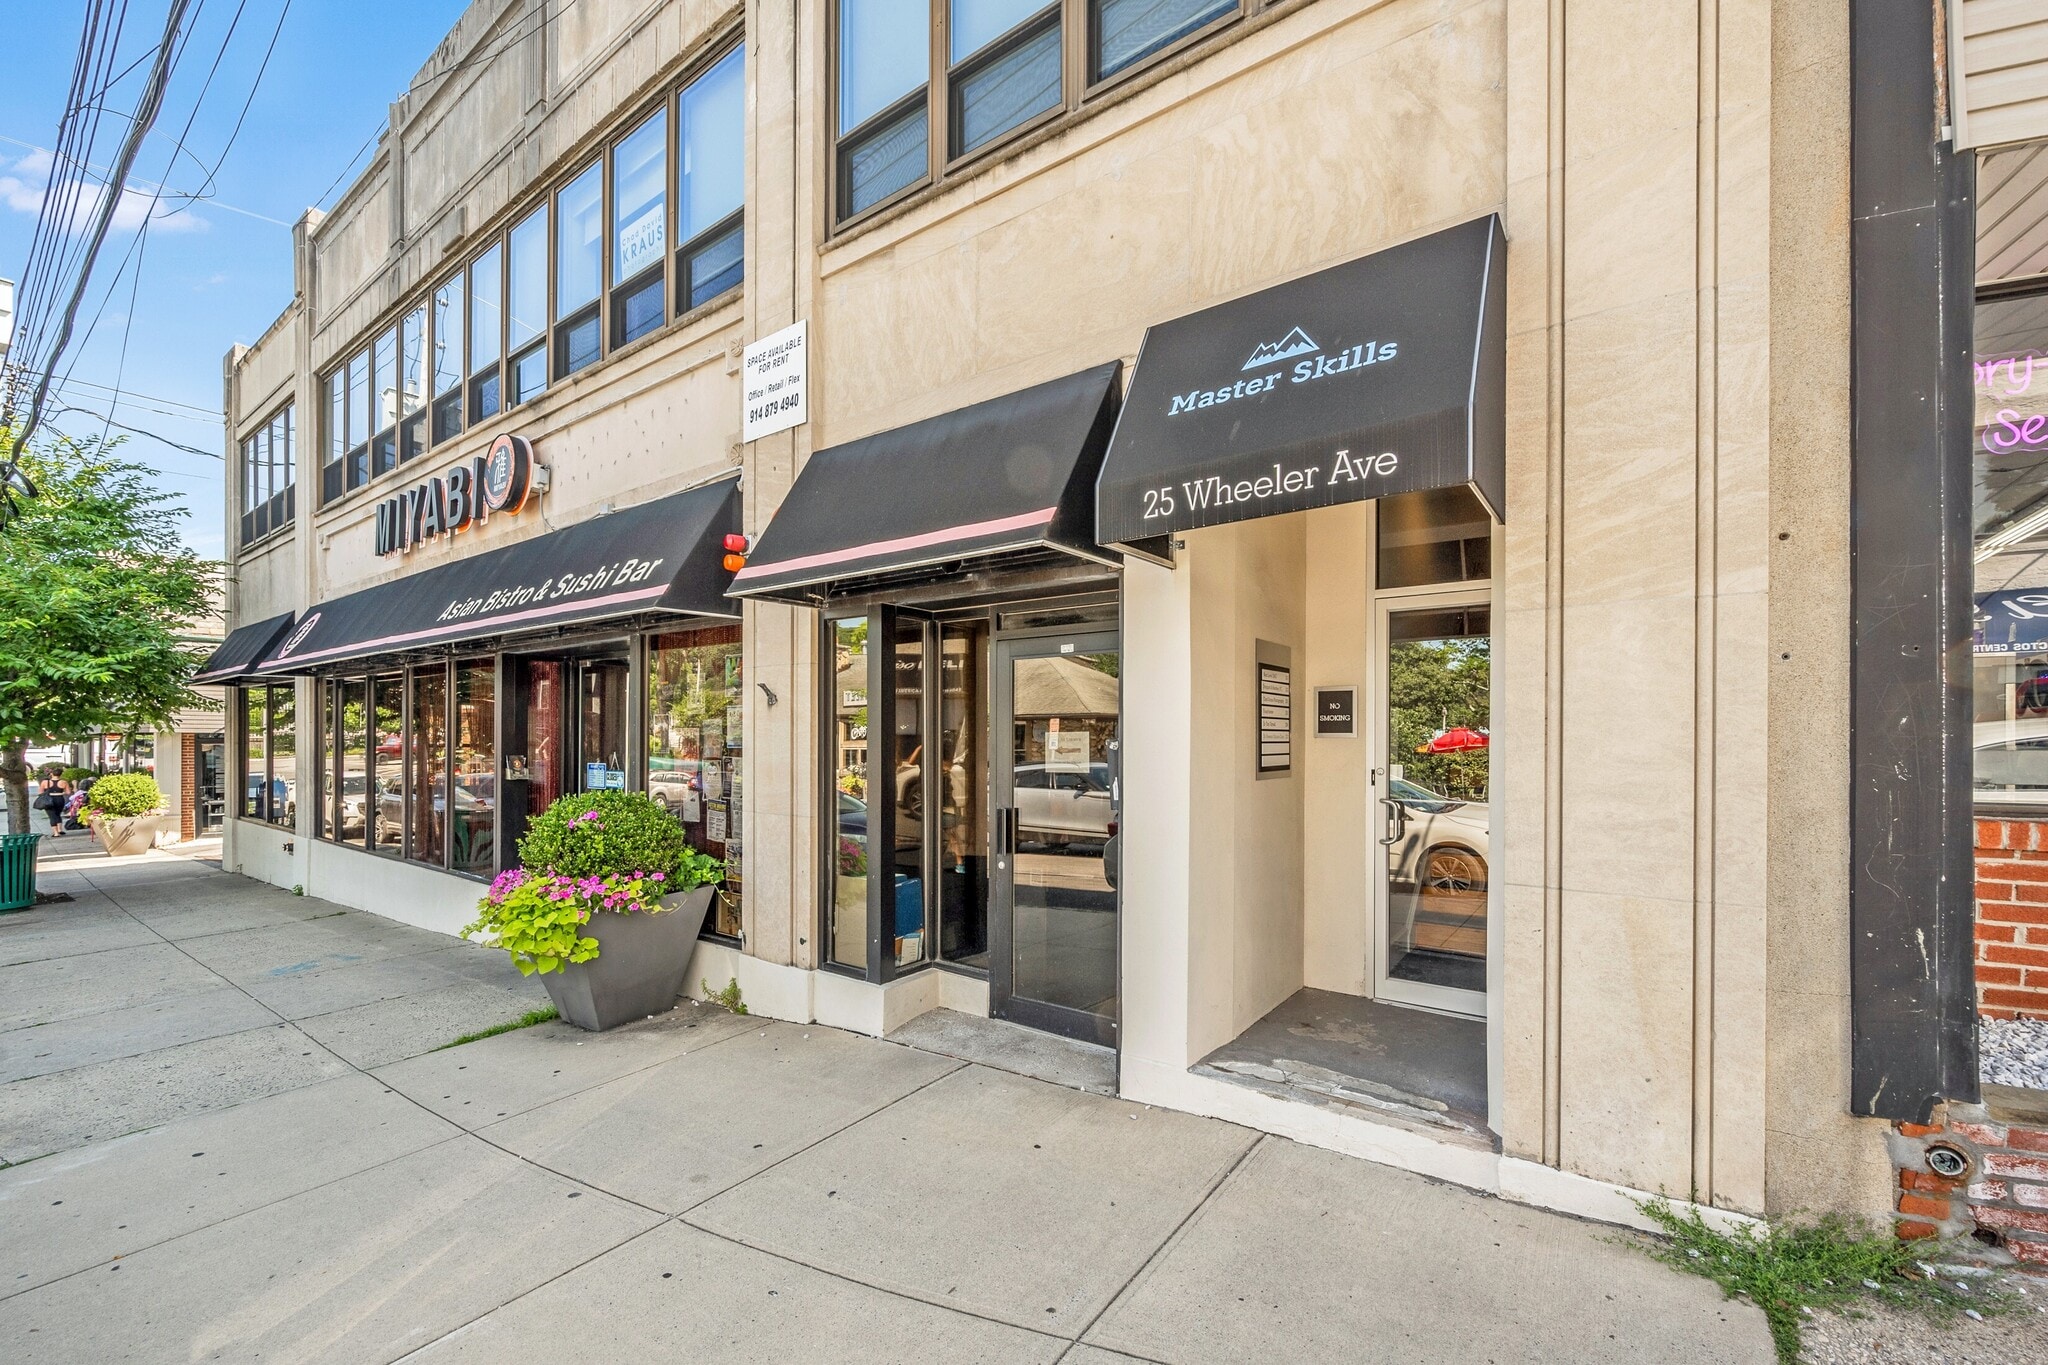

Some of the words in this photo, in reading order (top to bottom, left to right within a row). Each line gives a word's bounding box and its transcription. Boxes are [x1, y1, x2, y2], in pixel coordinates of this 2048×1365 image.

[622, 230, 639, 246] Chad
[642, 213, 662, 232] David
[622, 225, 663, 264] KRAUS
[747, 351, 766, 367] SPACE
[768, 336, 801, 358] AVAILABLE
[758, 361, 770, 374] FOR
[772, 354, 789, 368] RENT
[748, 388, 763, 401] Office
[768, 379, 784, 393] Retail
[788, 374, 800, 386] Flex
[1168, 371, 1282, 416] Master
[1291, 340, 1398, 384] Skills
[750, 407, 763, 423] 914
[765, 401, 778, 418] 879
[780, 393, 799, 411] 4940
[1143, 487, 1175, 519] 25
[1183, 464, 1319, 511] Wheeler
[1327, 450, 1398, 485] Ave
[375, 456, 487, 556] MIYABI
[437, 599, 482, 622] Asian
[482, 587, 535, 612] Bistro
[532, 578, 553, 602] &
[550, 563, 616, 598] Sushi
[612, 558, 664, 586] Bar
[1319, 714, 1351, 722] SMOKING
[1329, 702, 1340, 710] NO
